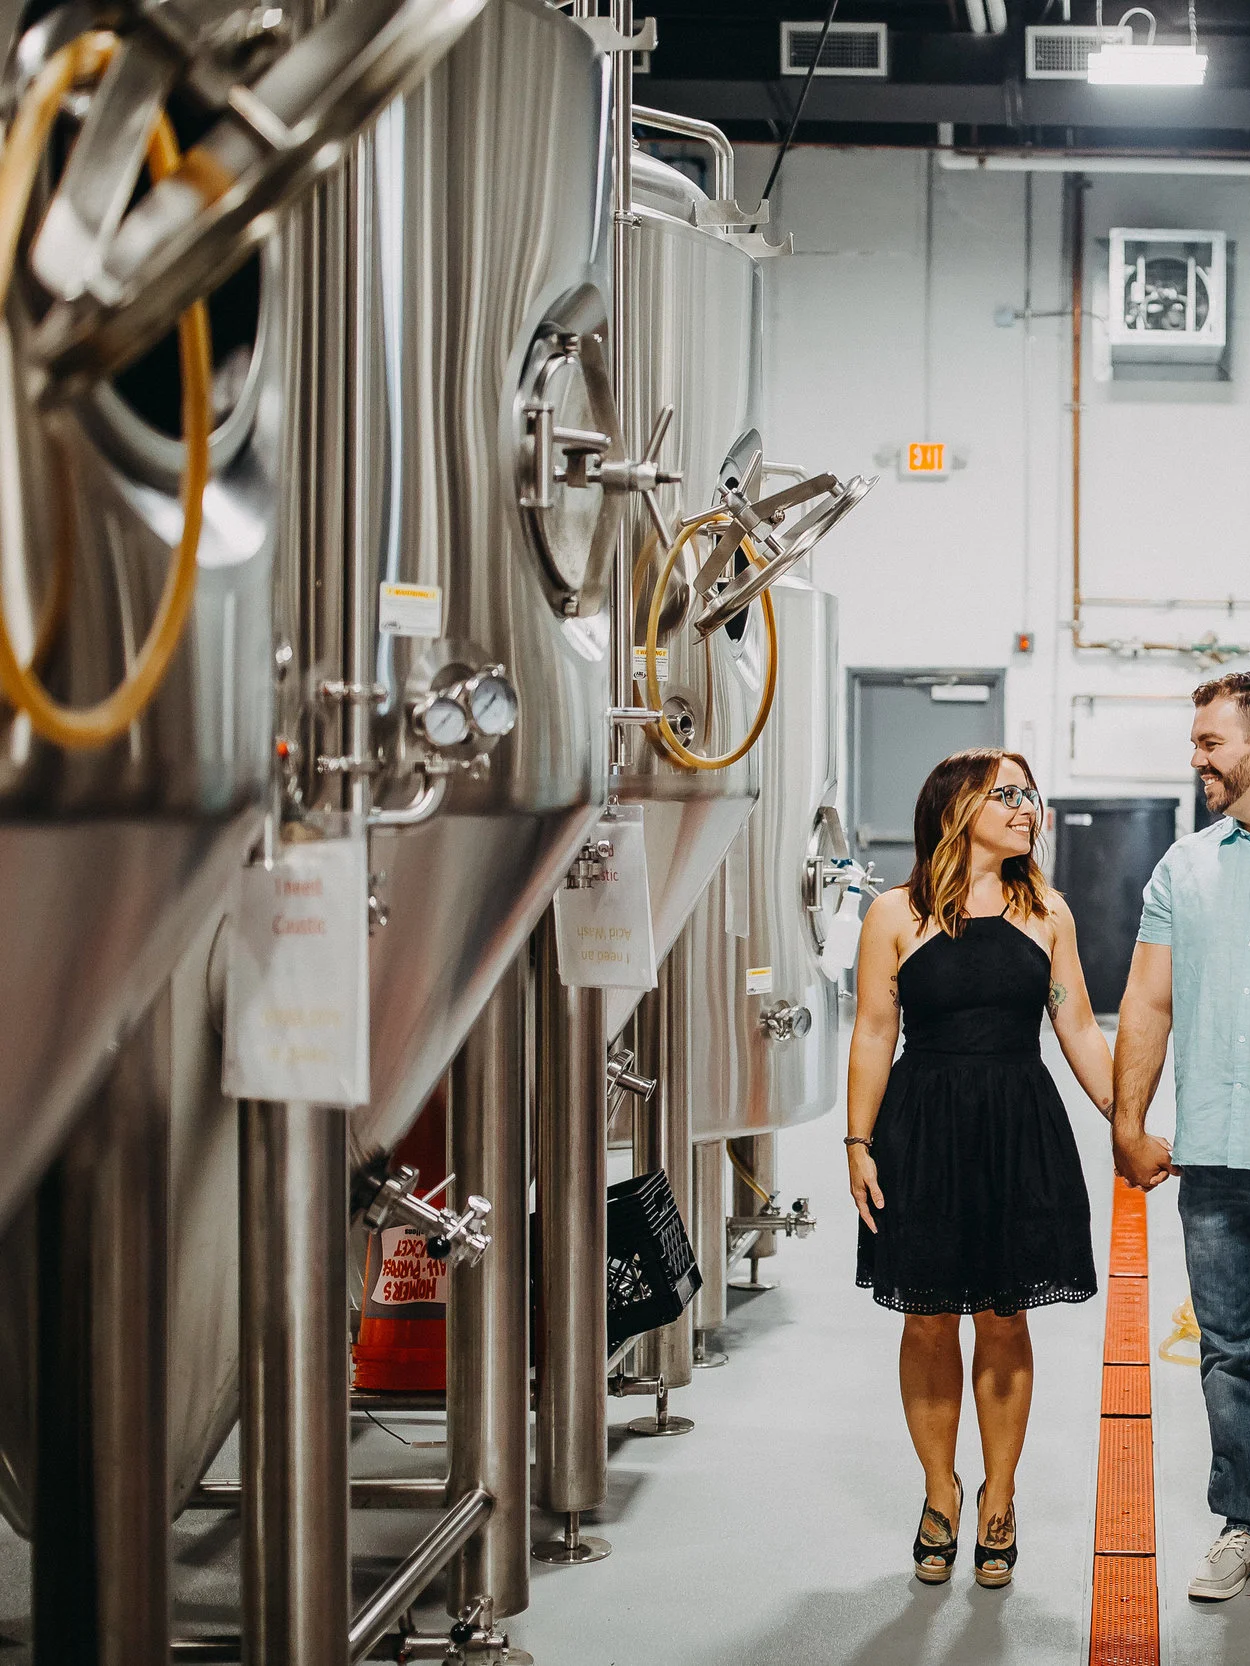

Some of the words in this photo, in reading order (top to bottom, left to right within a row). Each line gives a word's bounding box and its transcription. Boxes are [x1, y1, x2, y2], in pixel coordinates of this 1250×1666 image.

[908, 443, 945, 471] EXIT
[600, 869, 619, 882] stic
[394, 1239, 430, 1259] UCKET
[383, 1277, 437, 1302] HOMER'S
